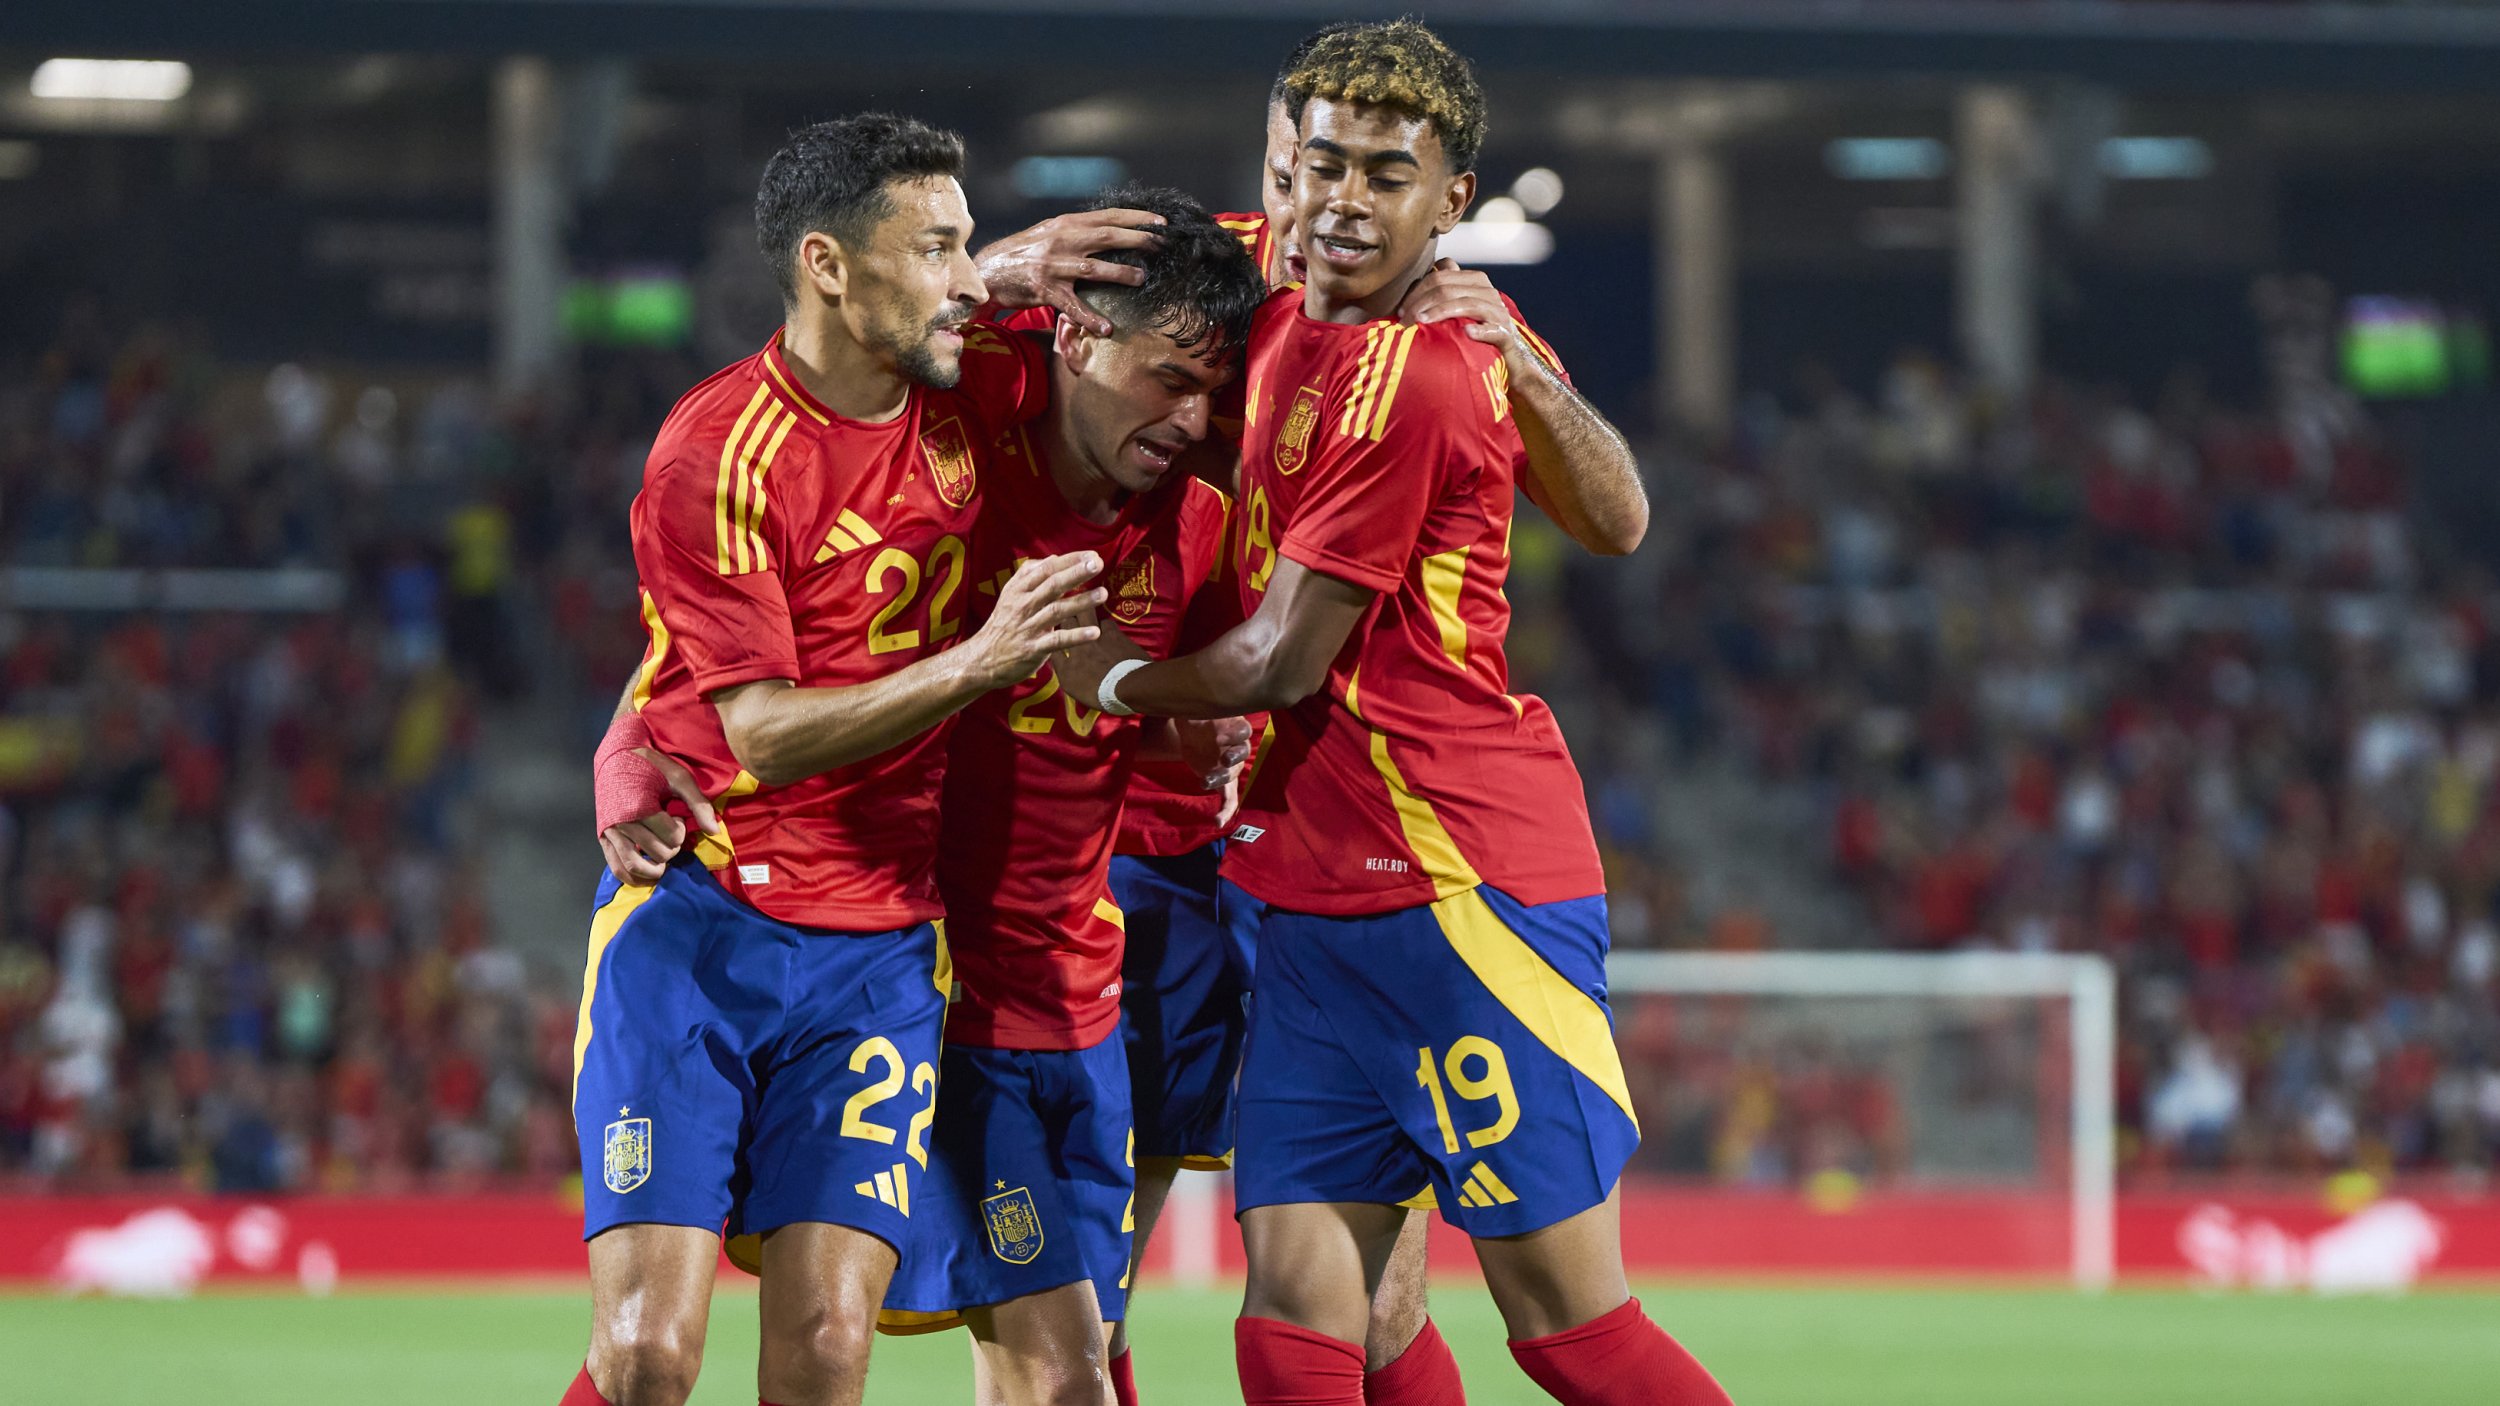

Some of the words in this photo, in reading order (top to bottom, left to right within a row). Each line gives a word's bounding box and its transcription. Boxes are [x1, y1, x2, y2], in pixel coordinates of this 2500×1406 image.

[865, 534, 966, 656] 22
[1366, 857, 1409, 873] HEAT.RDY
[840, 1035, 937, 1172] 22
[1415, 1035, 1521, 1155] 19
